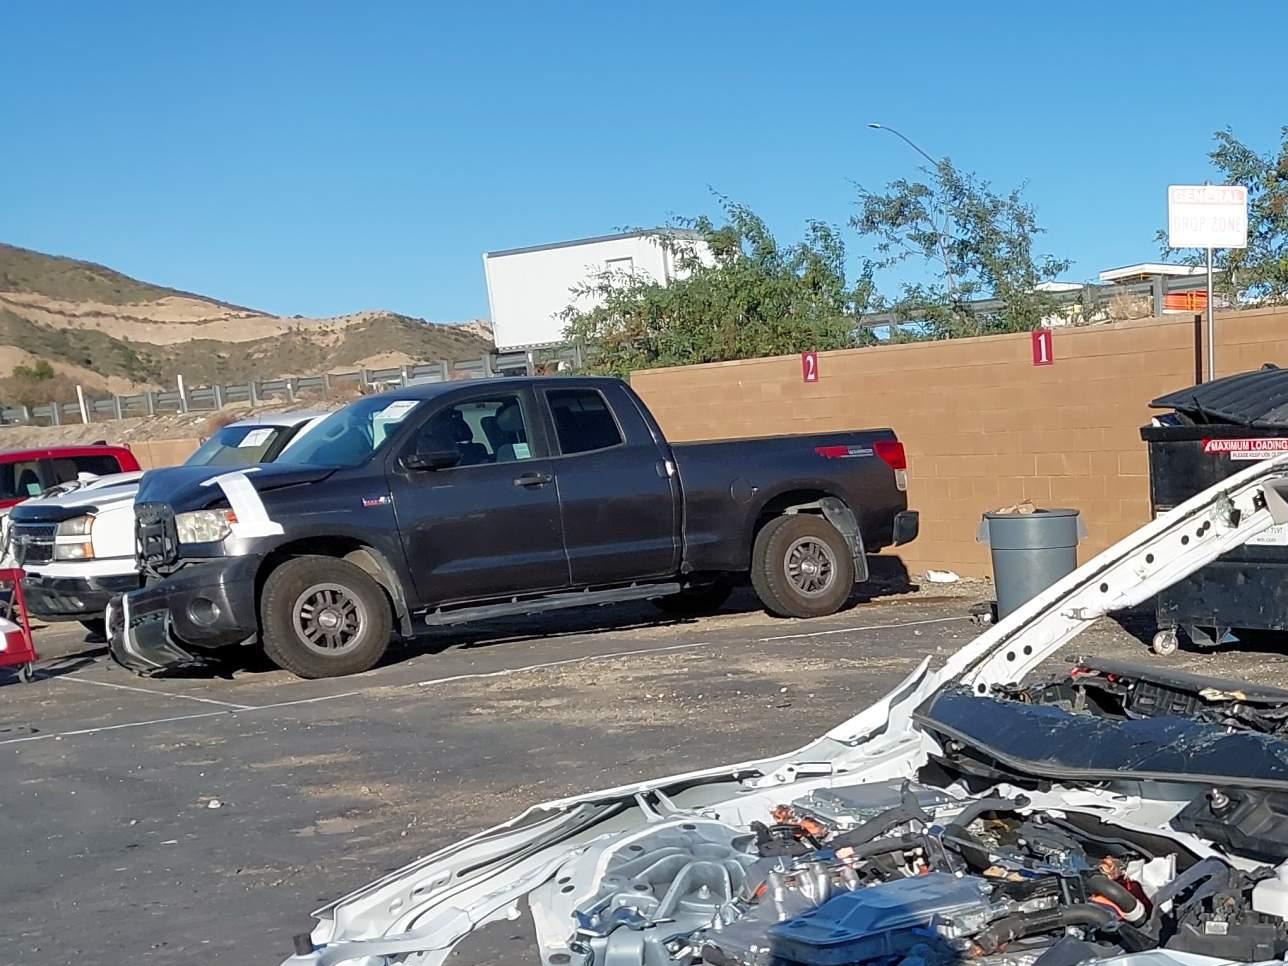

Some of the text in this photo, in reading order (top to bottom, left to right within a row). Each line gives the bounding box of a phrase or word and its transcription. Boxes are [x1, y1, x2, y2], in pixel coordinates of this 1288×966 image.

[1175, 190, 1244, 203] GENERAL
[1174, 216, 1242, 232] DROP ZONE
[1037, 333, 1049, 363] 1
[805, 354, 816, 380] 2
[1210, 440, 1249, 451] MAXIMUM
[1250, 440, 1288, 451] LOADING
